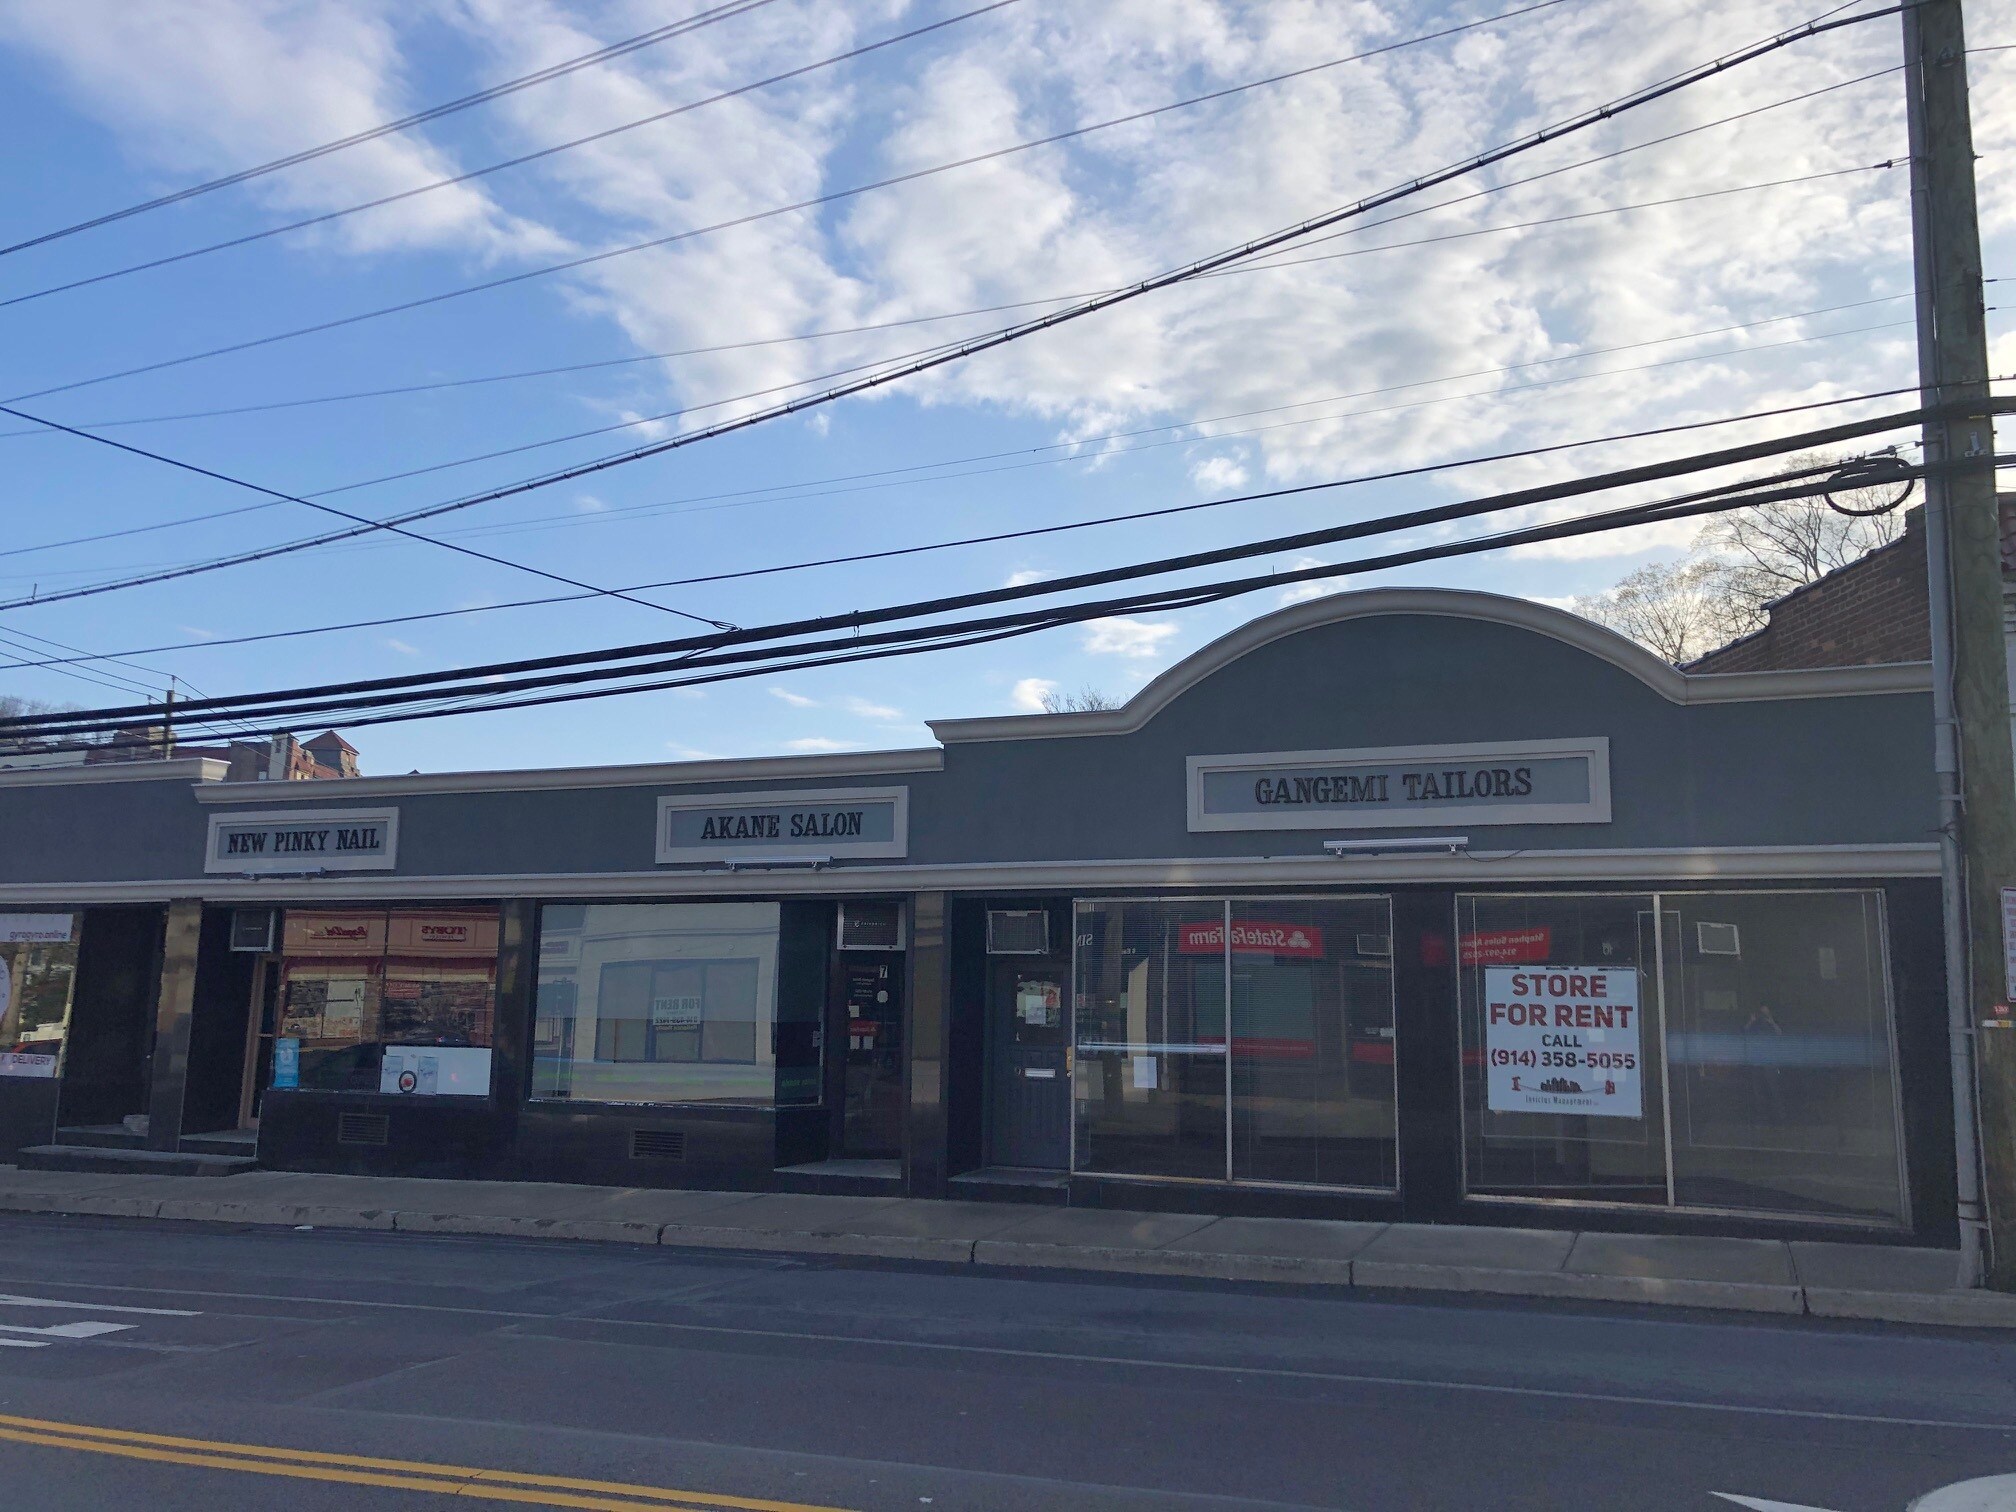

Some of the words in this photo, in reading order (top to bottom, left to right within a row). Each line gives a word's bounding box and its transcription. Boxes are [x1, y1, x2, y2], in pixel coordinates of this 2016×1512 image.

[1254, 774, 1390, 806] GANGEMI
[1402, 767, 1533, 801] TAILORS
[700, 813, 780, 840] AKANE
[790, 811, 864, 838] SALON
[227, 832, 267, 854] NEW
[273, 830, 330, 852] PINKY
[335, 828, 380, 850] NAIL
[1511, 973, 1607, 998] STORE
[1490, 1002, 1549, 1027] FOR
[1554, 1004, 1634, 1029] RENT
[1541, 1034, 1583, 1048] CALL
[12, 1054, 52, 1066] DELIVERY
[1490, 1048, 1537, 1068] (914)
[1541, 1051, 1636, 1070] 358-5055
[1553, 1096, 1593, 1107] Management
